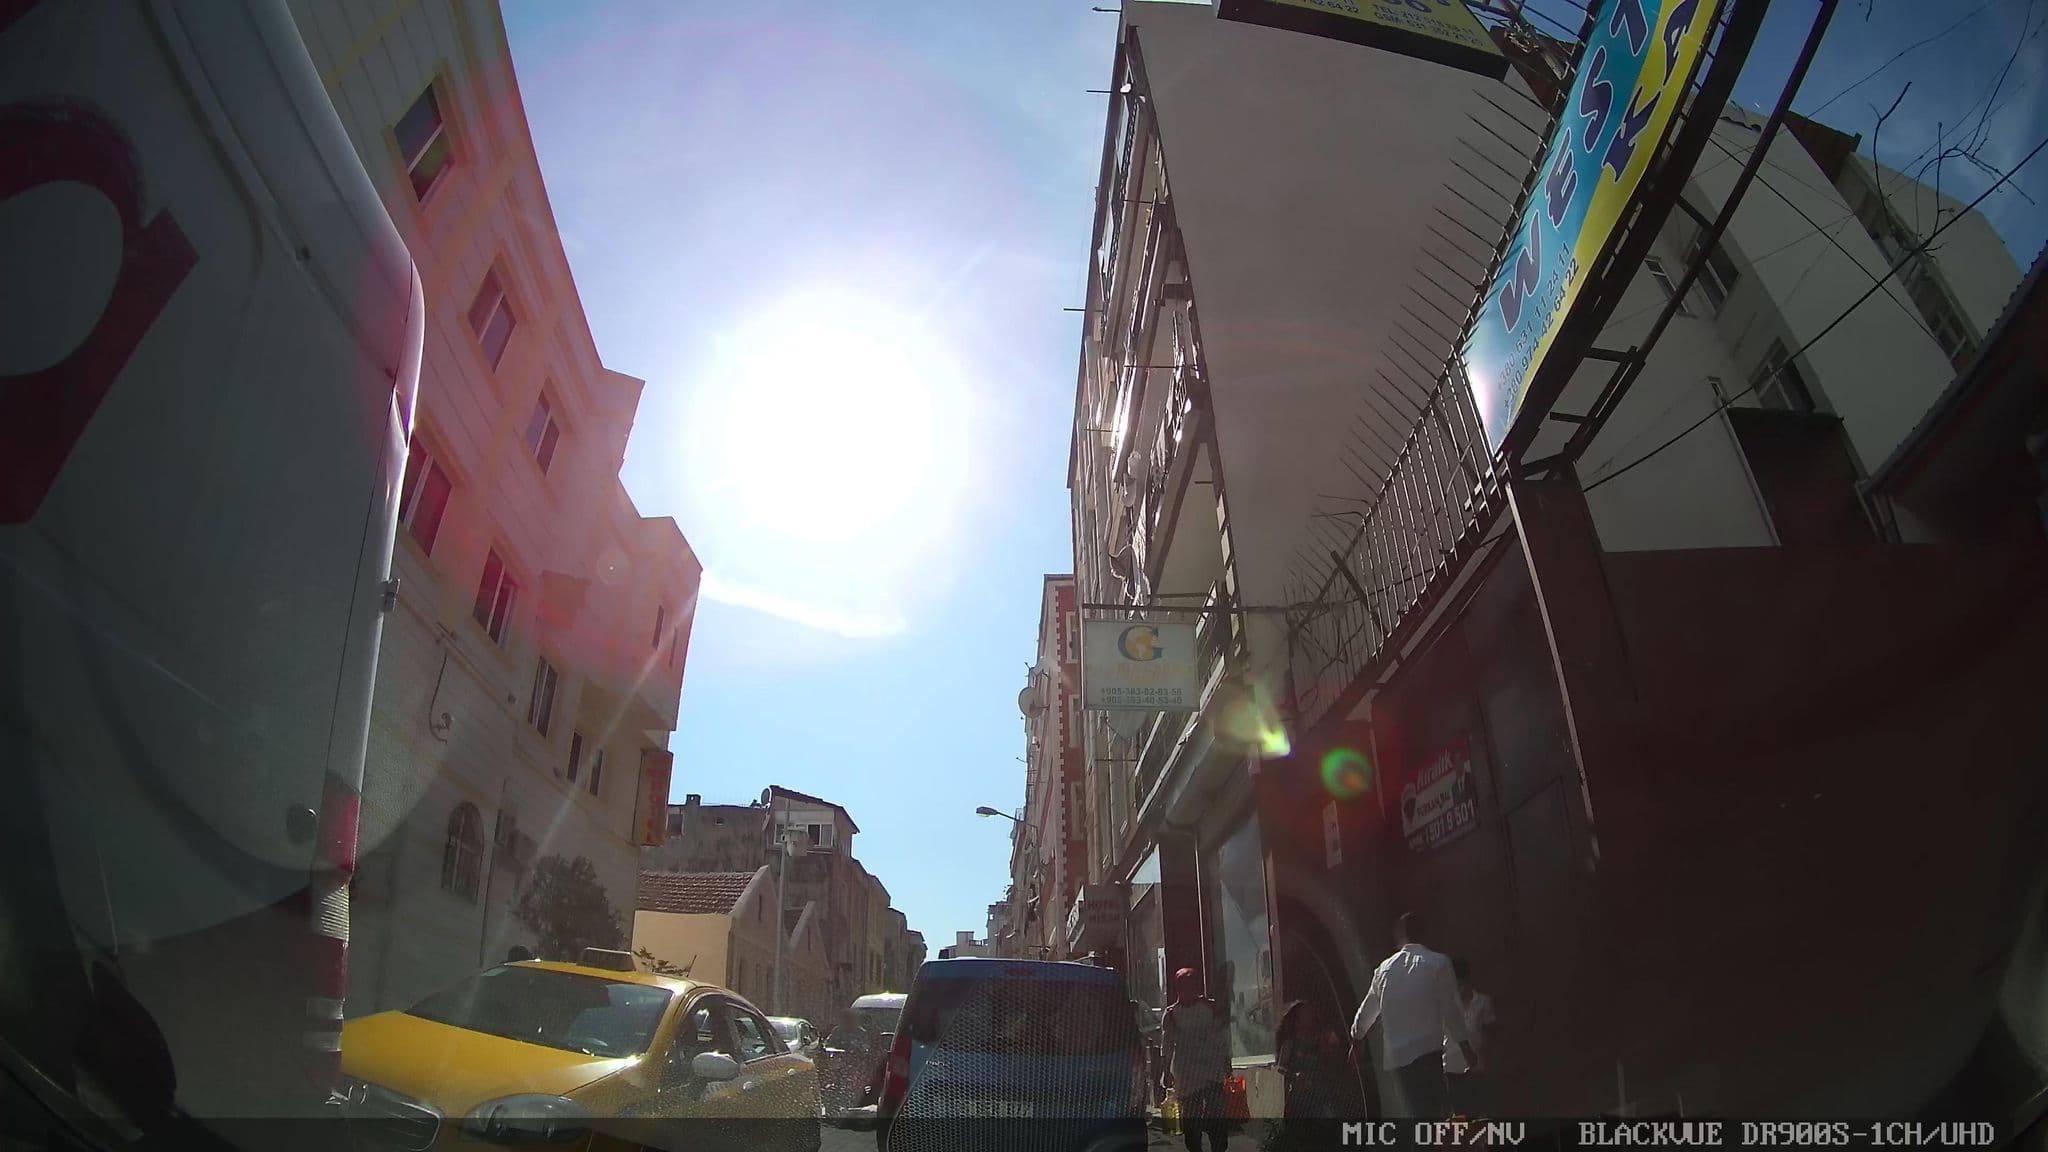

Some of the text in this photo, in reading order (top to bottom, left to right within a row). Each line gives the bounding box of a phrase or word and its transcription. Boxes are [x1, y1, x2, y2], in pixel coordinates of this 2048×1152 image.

[1522, 336, 1539, 371] 974
[1542, 312, 1554, 337] 42
[1554, 286, 1566, 312] 64
[1566, 257, 1579, 288] 22
[1535, 296, 1547, 318] 11
[1548, 270, 1560, 296] 24
[1559, 241, 1570, 265] 11
[1455, 798, 1475, 826] 501
